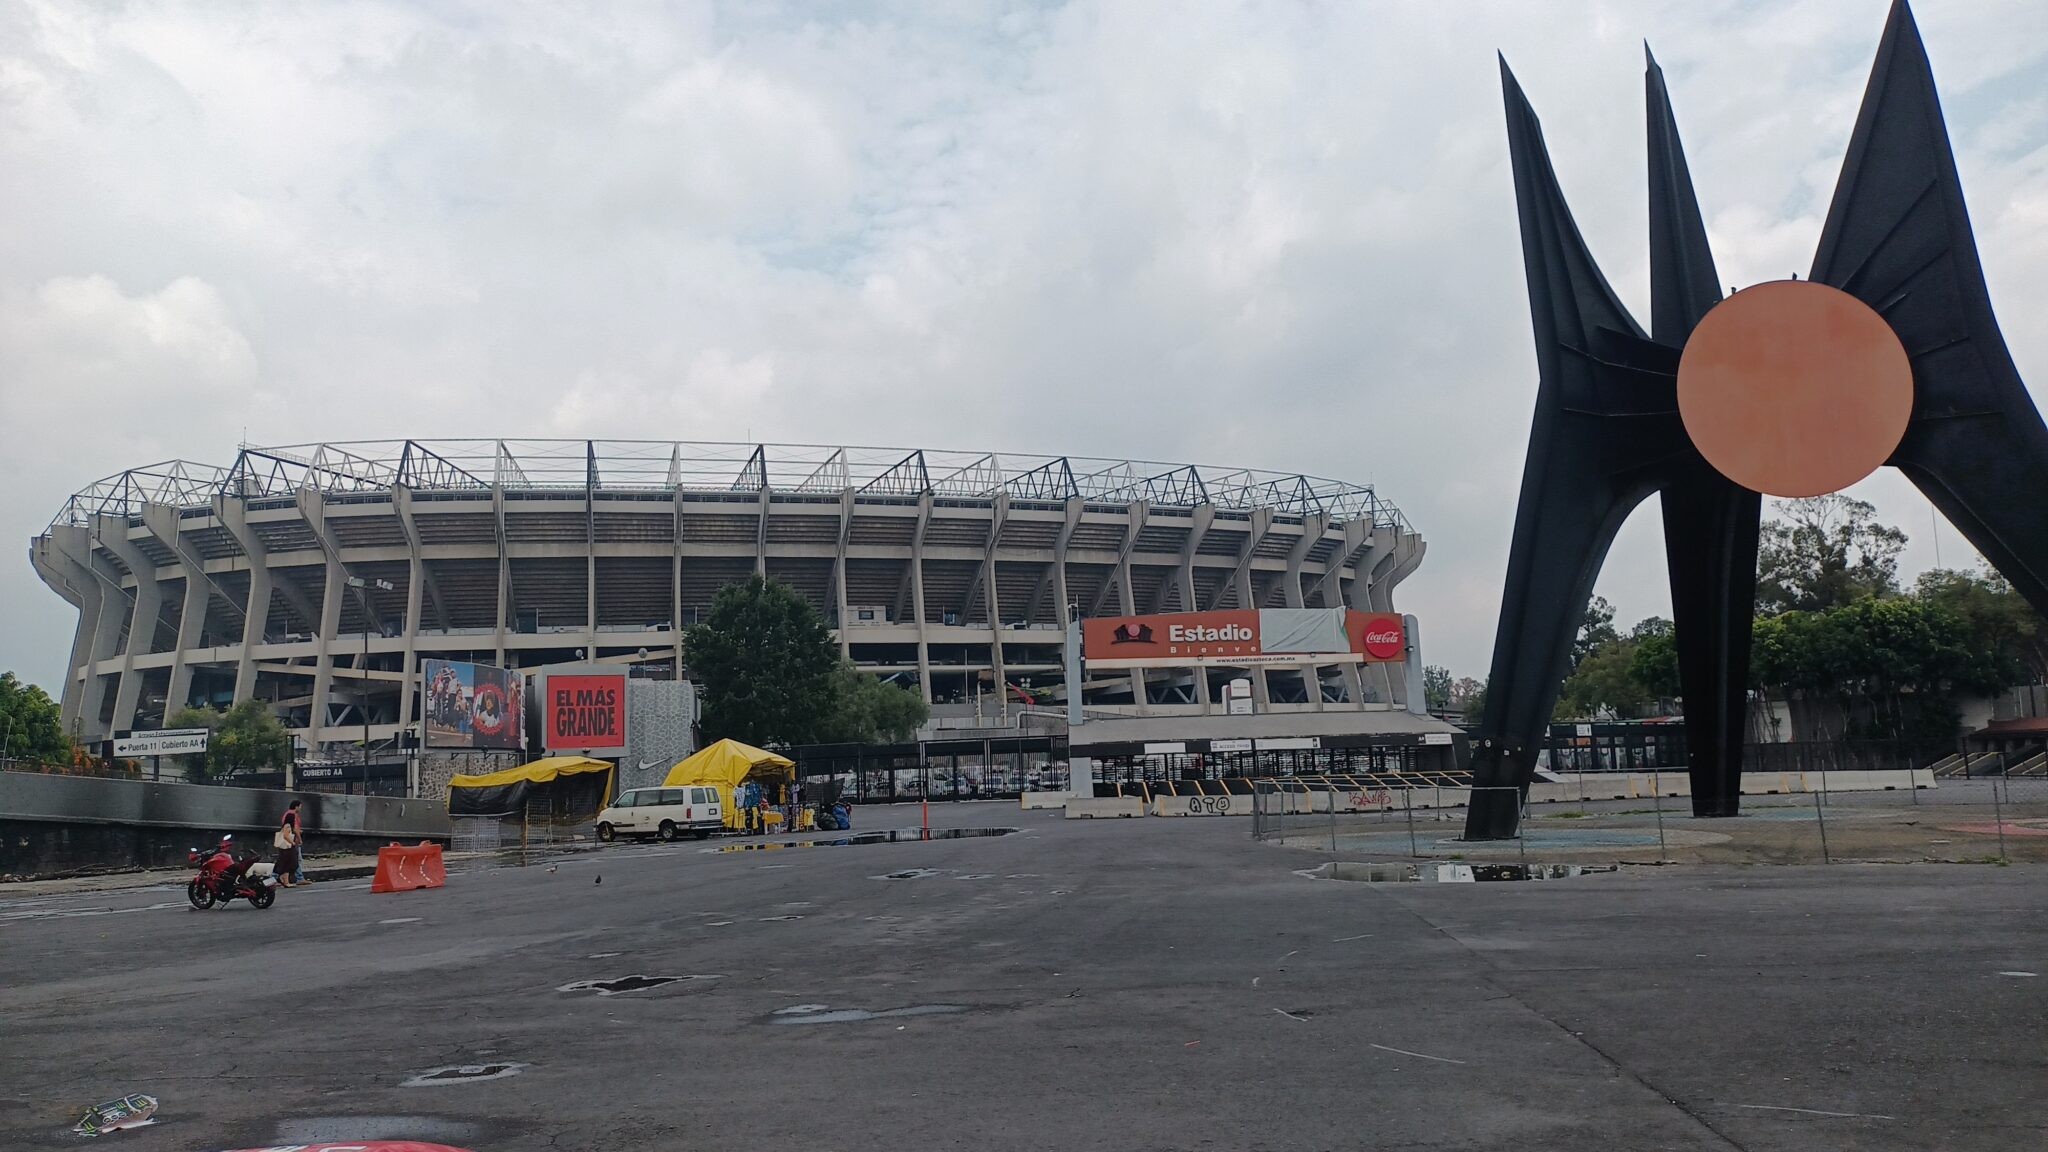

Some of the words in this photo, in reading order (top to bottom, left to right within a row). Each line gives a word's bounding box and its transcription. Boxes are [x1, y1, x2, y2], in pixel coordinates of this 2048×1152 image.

[1169, 623, 1253, 642] Estadio
[556, 690, 574, 707] EL
[576, 685, 616, 707] MÁS
[128, 743, 148, 752] Puerta
[150, 742, 157, 750] 11
[161, 740, 188, 750] Cubierto
[189, 739, 199, 747] AA
[302, 769, 332, 777] CUBIERTO
[333, 768, 343, 776] AA
